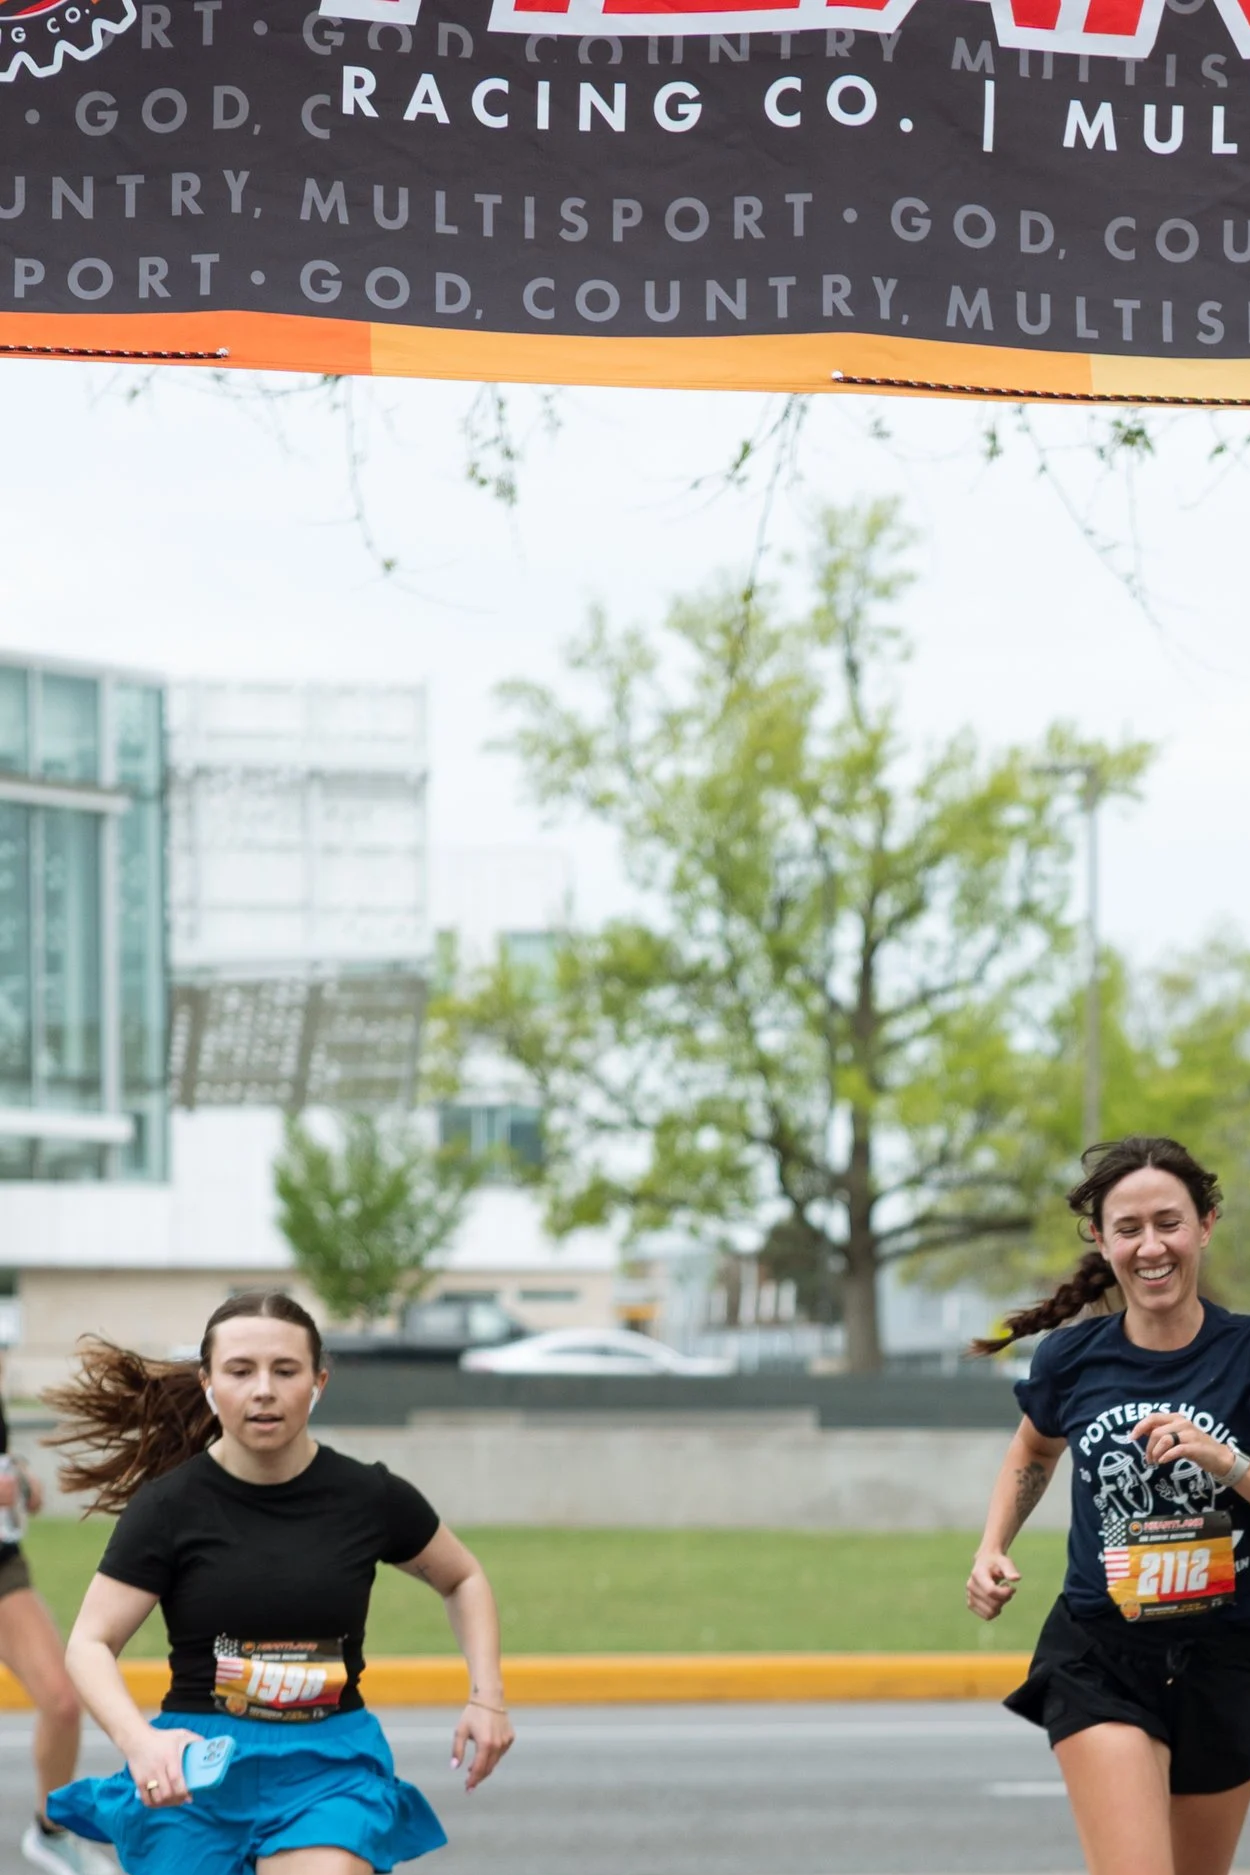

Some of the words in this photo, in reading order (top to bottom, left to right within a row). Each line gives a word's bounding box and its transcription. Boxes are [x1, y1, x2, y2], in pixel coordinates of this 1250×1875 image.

[75, 85, 262, 137] GOD,
[342, 65, 704, 133] RACING
[764, 74, 914, 133] CO.
[299, 177, 814, 243] MULTISPORT
[890, 196, 1067, 261] GOD,
[300, 259, 484, 320] GOD,
[523, 273, 910, 326] COUNTRY,
[1079, 1402, 1172, 1456] POTTER'S
[1178, 1403, 1239, 1449] HOUS
[1136, 1547, 1211, 1597] 2112
